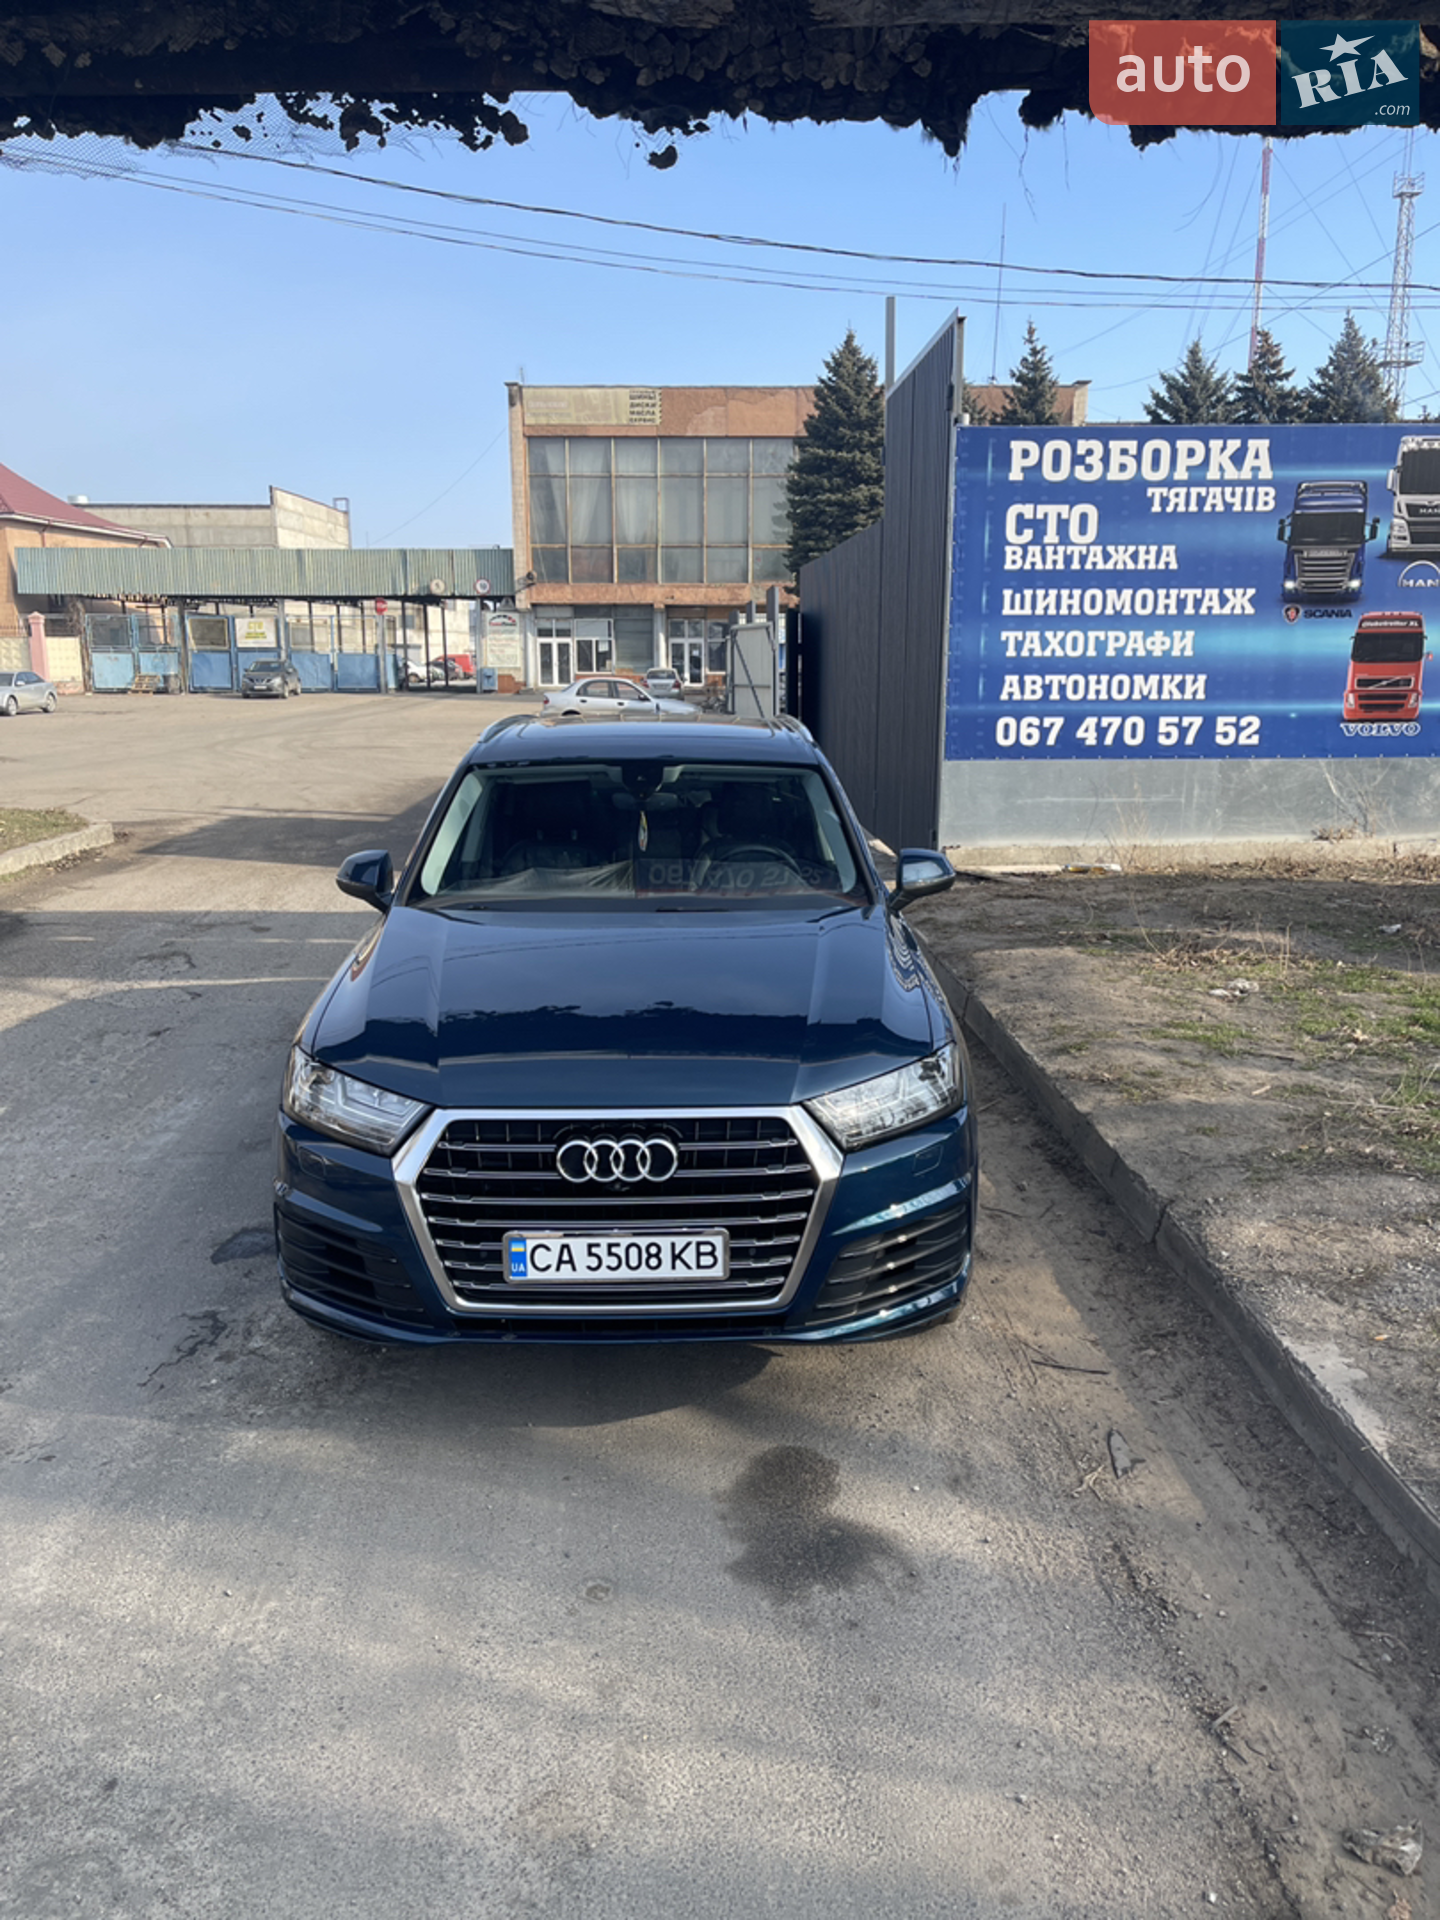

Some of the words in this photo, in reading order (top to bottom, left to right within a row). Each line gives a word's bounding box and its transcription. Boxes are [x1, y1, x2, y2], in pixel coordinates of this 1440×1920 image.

[1008, 438, 1274, 482] РОЗБОРКА
[1146, 486, 1277, 513] ТЯГАЧІВ
[1005, 503, 1099, 545] СТО
[1003, 545, 1178, 570] ВАНТАЖНА
[1402, 579, 1439, 587] MAN
[1001, 588, 1256, 616] ШИНОМОНТАЖ
[1303, 608, 1352, 618] SCANIA
[1000, 630, 1195, 657] ТАХОГРАФИ
[1000, 674, 1207, 701] АВТОНОМКИ
[995, 716, 1064, 746] 067
[1075, 716, 1145, 746] 470
[1157, 716, 1203, 746] 57
[1214, 715, 1261, 746] 52
[1340, 722, 1421, 736] VOLVO
[511, 1262, 526, 1273] UA
[529, 1243, 577, 1273] CA
[586, 1242, 662, 1272] 5508
[670, 1240, 718, 1271] KB
